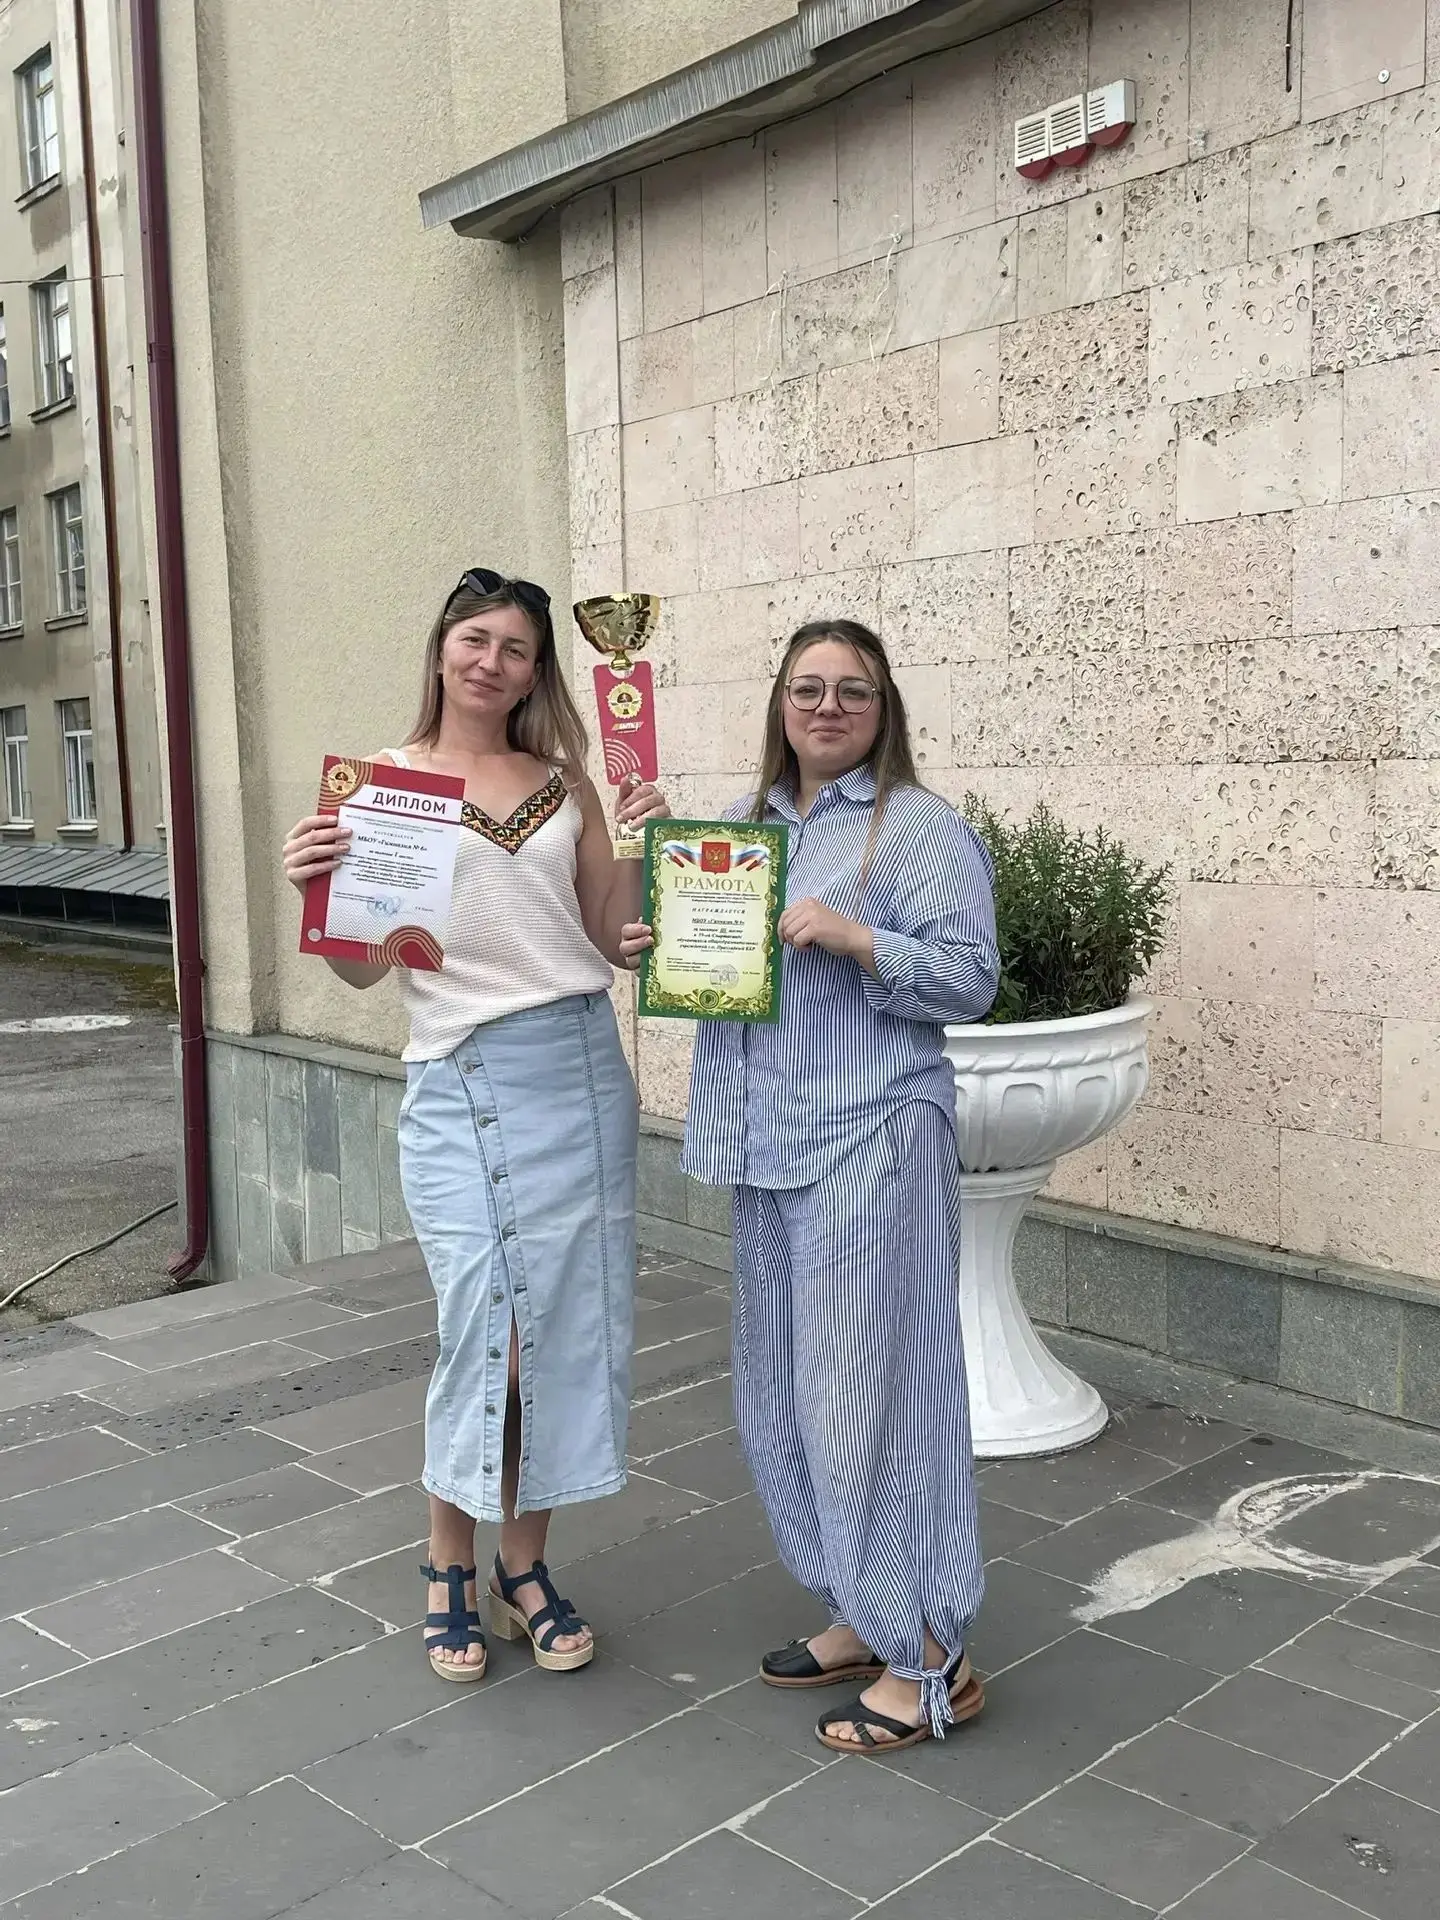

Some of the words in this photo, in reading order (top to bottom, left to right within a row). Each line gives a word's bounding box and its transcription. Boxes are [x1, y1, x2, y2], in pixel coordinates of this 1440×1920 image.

[372, 792, 446, 814] ДИПЛОМ
[357, 835, 377, 844] МБОУ
[673, 876, 755, 892] ГРАМОТА
